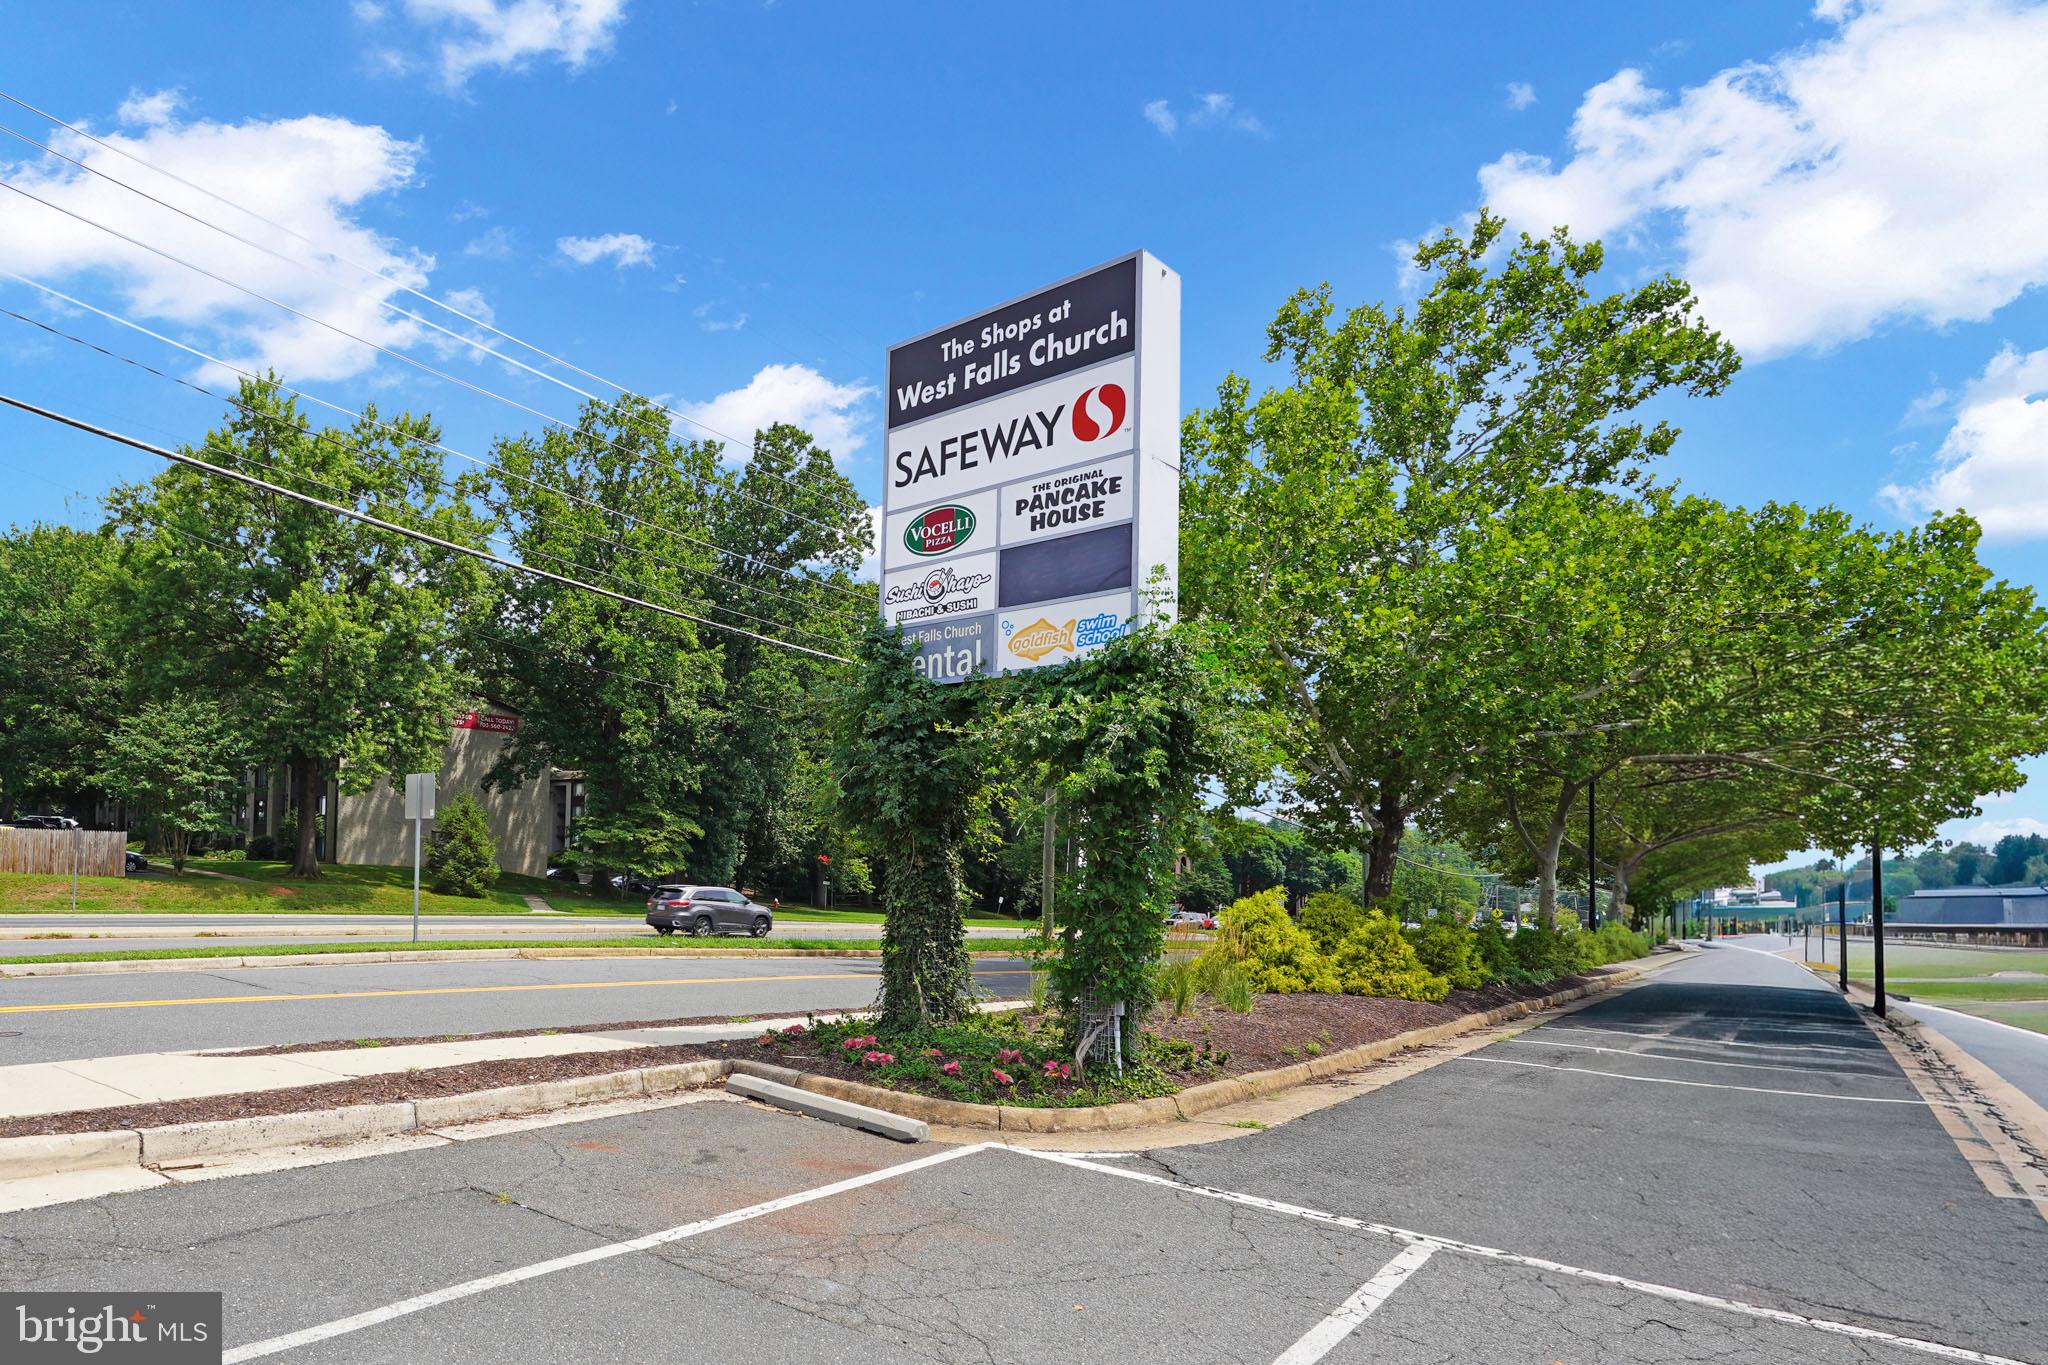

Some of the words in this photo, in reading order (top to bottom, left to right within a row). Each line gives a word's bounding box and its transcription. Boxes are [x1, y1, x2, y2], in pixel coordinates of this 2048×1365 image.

[941, 337, 974, 362] The
[981, 311, 1041, 349] Shops
[1048, 299, 1071, 322] at
[897, 374, 956, 411] West
[964, 349, 1020, 390] Falls
[1029, 310, 1128, 366] Church
[895, 404, 1066, 488] SAFEWAY
[1032, 482, 1051, 493] THE
[1054, 469, 1104, 488] ORIGINAL
[1016, 476, 1122, 516] PANCAKE
[1030, 500, 1105, 531] HOUSE
[911, 516, 971, 541] VOCELLI
[926, 536, 952, 548] PIZZA
[885, 582, 925, 605] Sushi
[896, 606, 934, 621] HIBACHI
[936, 604, 944, 614] &
[947, 598, 978, 613] SUSHI
[901, 633, 916, 646] est
[919, 628, 942, 642] Falls
[944, 622, 982, 639] Church
[1077, 613, 1117, 633] swim
[1013, 629, 1068, 652] goldfish
[1076, 624, 1127, 647] school
[912, 639, 982, 679] ental
